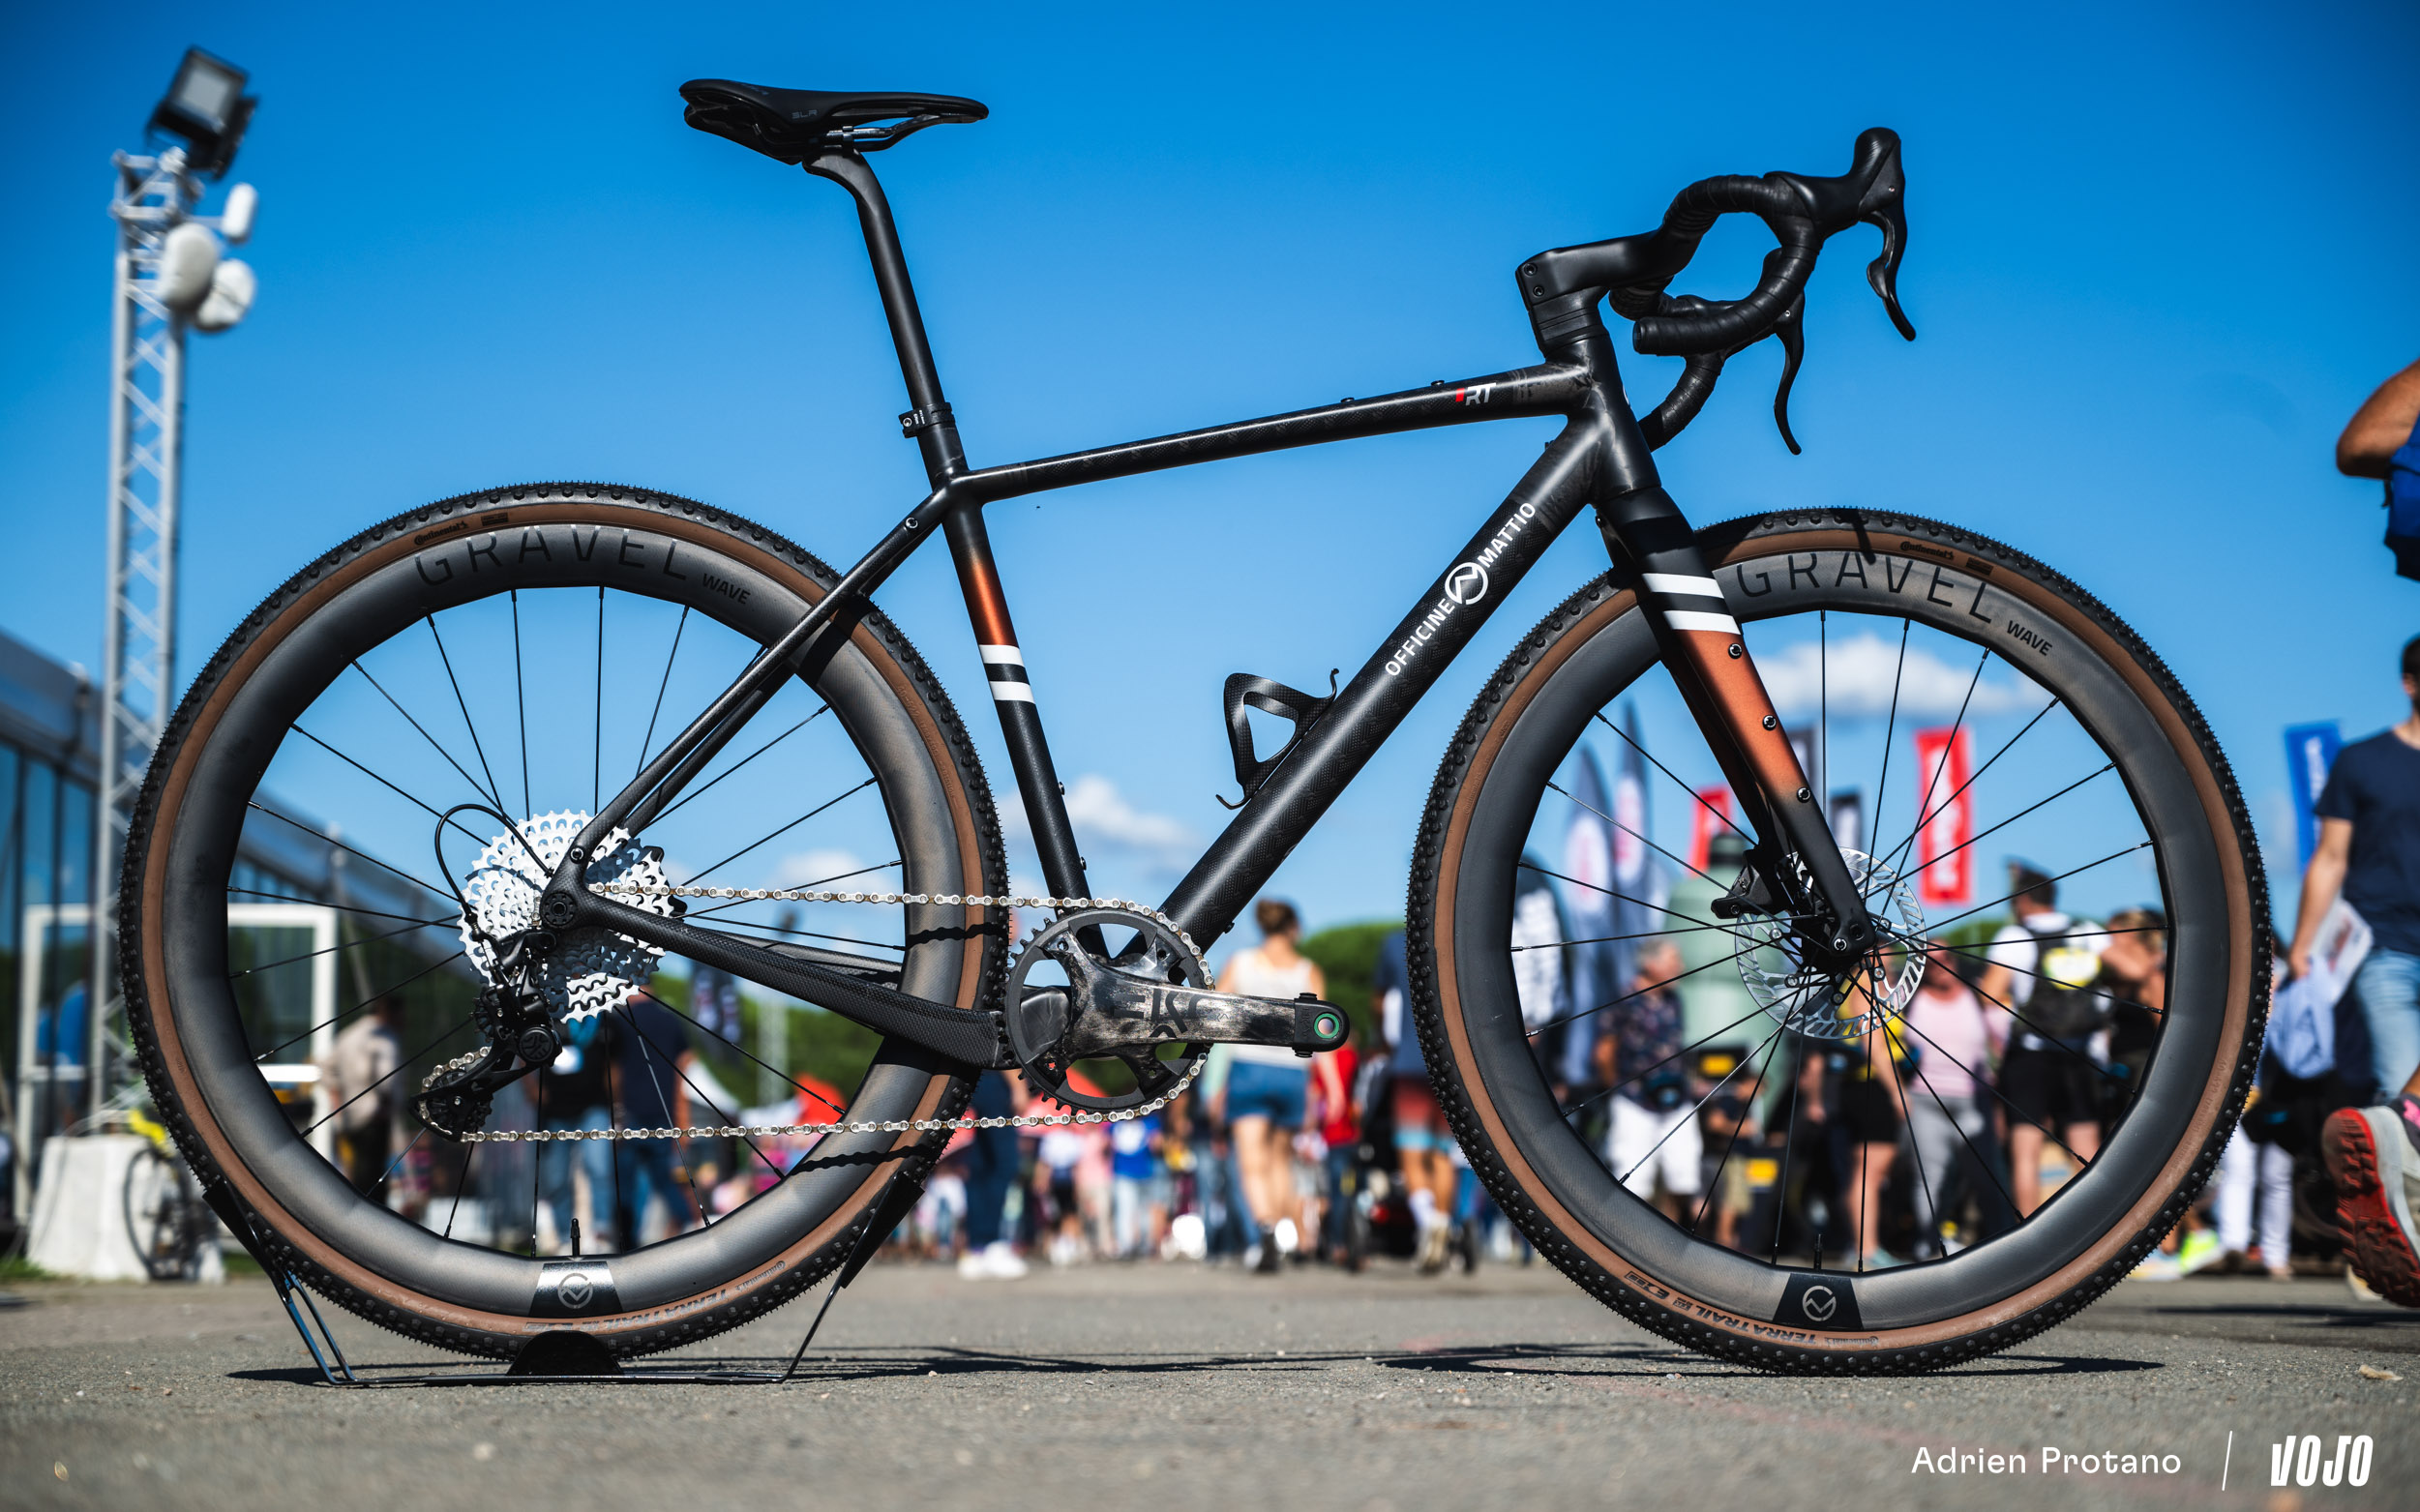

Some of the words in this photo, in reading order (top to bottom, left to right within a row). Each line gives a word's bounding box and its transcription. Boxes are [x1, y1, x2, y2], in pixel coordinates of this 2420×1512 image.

[792, 108, 818, 119] SLR
[414, 523, 687, 586] GRAVEL
[702, 573, 751, 605] WAVE
[1385, 598, 1455, 676] OFFICINE
[1477, 502, 1537, 568] MATTIO
[1736, 550, 1992, 624] GRAVEL
[2007, 620, 2053, 657] WAVE
[665, 1290, 729, 1318] TERRA
[604, 1311, 659, 1330] TRAIL
[1696, 1305, 1749, 1332] TRAIL
[1753, 1323, 1818, 1345] TERRA
